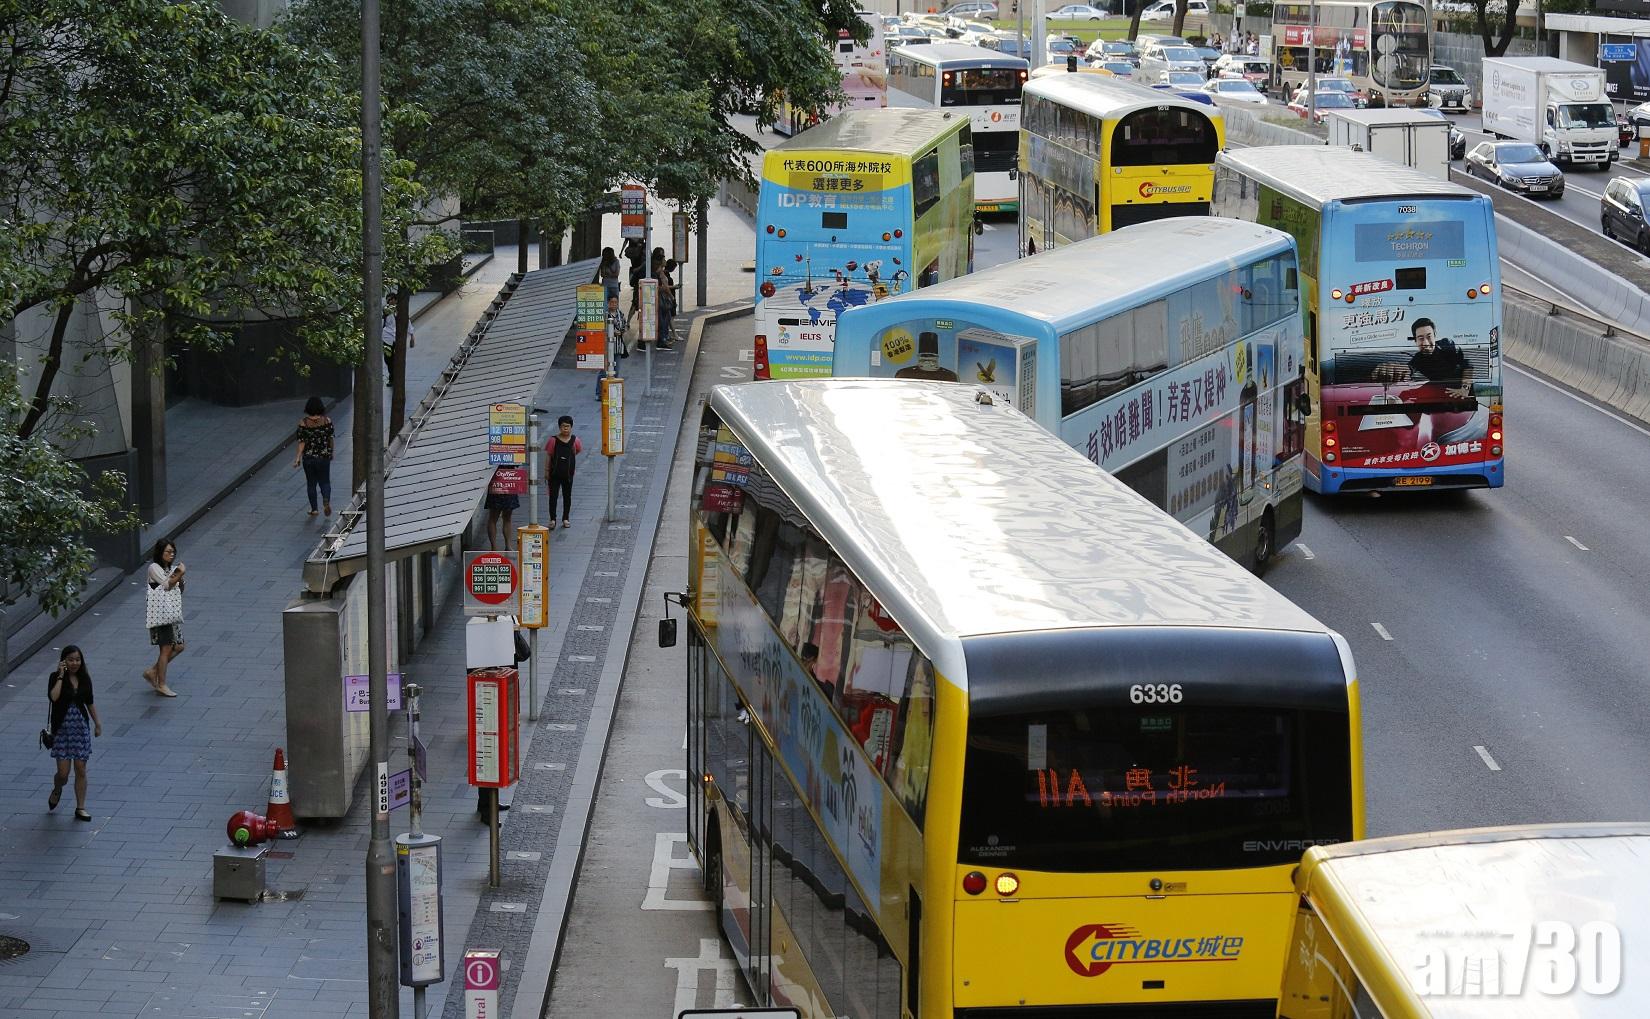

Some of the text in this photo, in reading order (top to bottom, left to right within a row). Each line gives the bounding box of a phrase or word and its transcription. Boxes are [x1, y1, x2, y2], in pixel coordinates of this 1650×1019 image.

[783, 159, 892, 173] 代表600所海外院校
[812, 177, 864, 191] 選擇更多
[1145, 186, 1177, 194] CITYBUS
[1391, 242, 1429, 251] TECHRON
[1342, 308, 1405, 329] 更強馬力
[800, 333, 822, 341] IELTS
[884, 335, 909, 350] 100%
[502, 426, 513, 434] 37B
[1444, 440, 1482, 456] 加德士
[490, 454, 501, 462] 12A
[1410, 477, 1431, 485] 2199
[1129, 683, 1183, 704] 6336
[380, 773, 388, 811] 49680
[1090, 935, 1244, 961] CITYBUS 城巴
